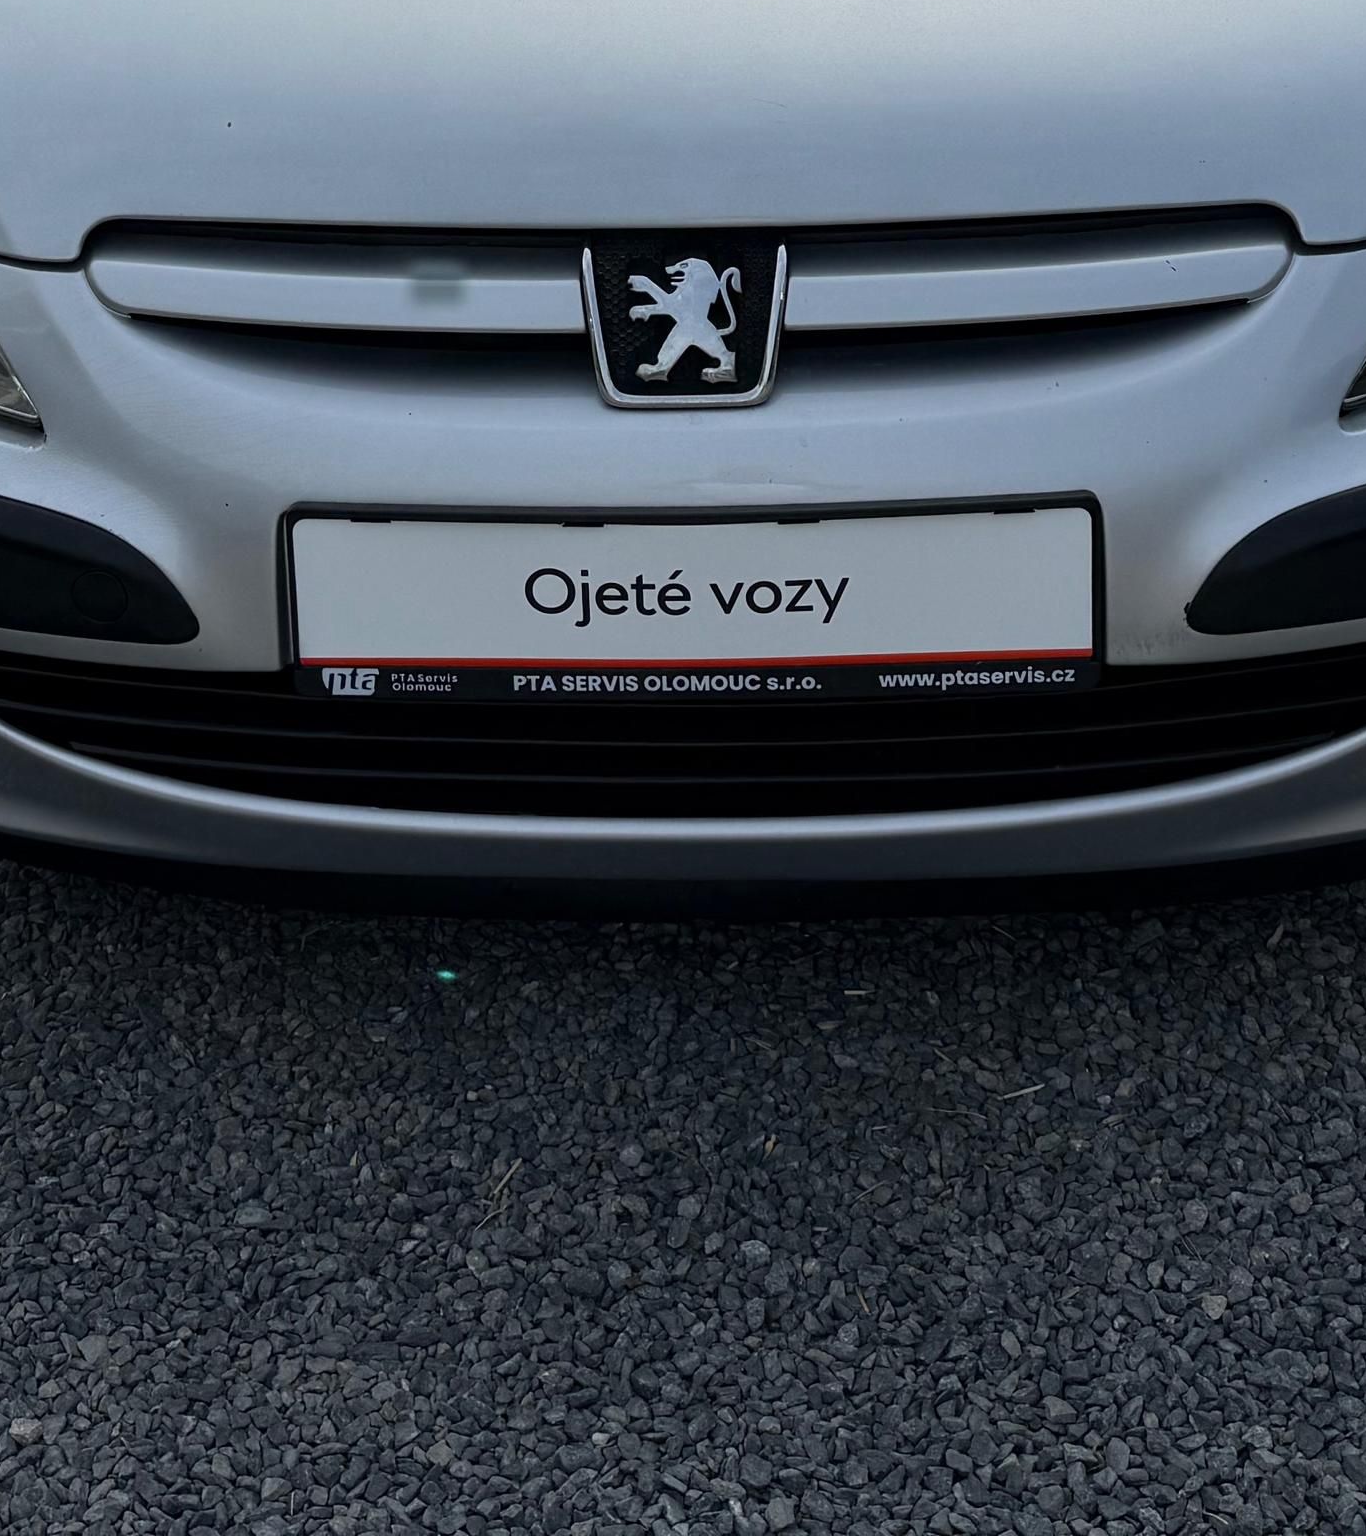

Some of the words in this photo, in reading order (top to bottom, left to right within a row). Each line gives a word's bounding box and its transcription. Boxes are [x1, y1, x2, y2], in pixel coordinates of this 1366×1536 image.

[524, 567, 692, 628] Ojeté
[708, 577, 850, 624] vozy
[325, 668, 378, 696] pta
[391, 673, 415, 683] PTA
[392, 682, 452, 692] Olomouc
[512, 674, 557, 691] PTA
[561, 674, 640, 692] SERVIS
[643, 674, 761, 692] OLOMOUC
[766, 675, 822, 691] s.r.o.
[878, 666, 1076, 691] www.ptaservis.cz
